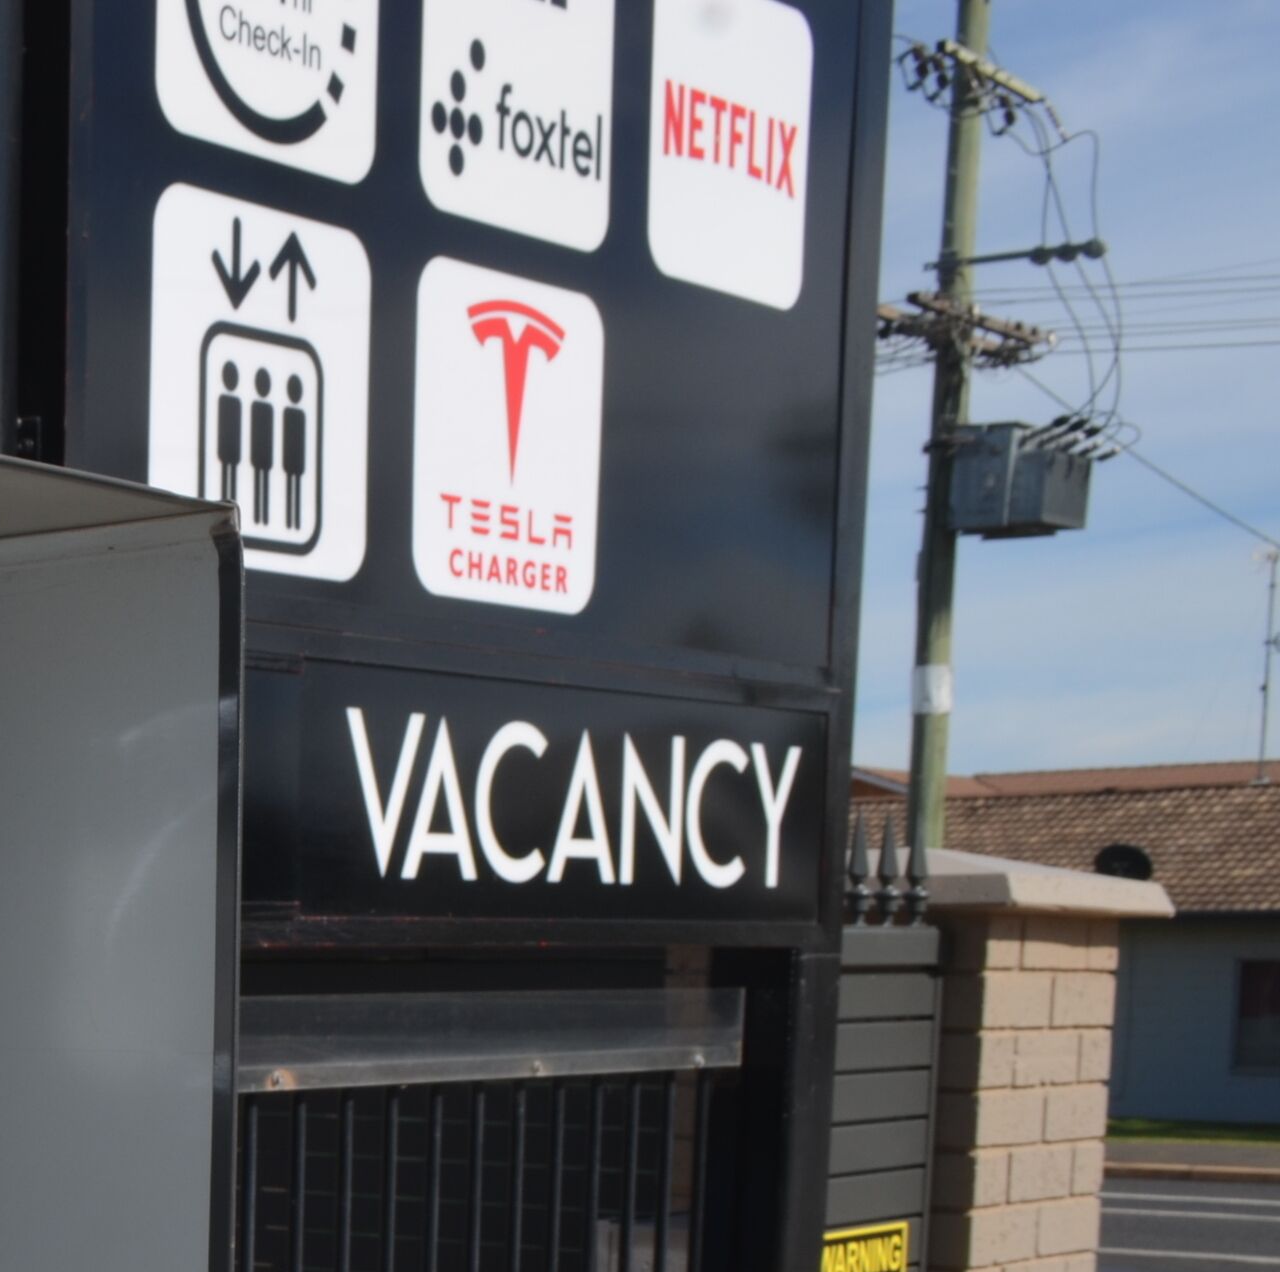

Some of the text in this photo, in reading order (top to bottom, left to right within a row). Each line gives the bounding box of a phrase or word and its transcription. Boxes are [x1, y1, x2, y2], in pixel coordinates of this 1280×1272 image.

[220, 5, 321, 71] Check-In
[496, 82, 602, 181] foxtel
[663, 79, 797, 199] NETFLIX
[440, 492, 572, 550] TESLA
[449, 548, 567, 593] CHARGER
[345, 707, 801, 889] VACANCY
